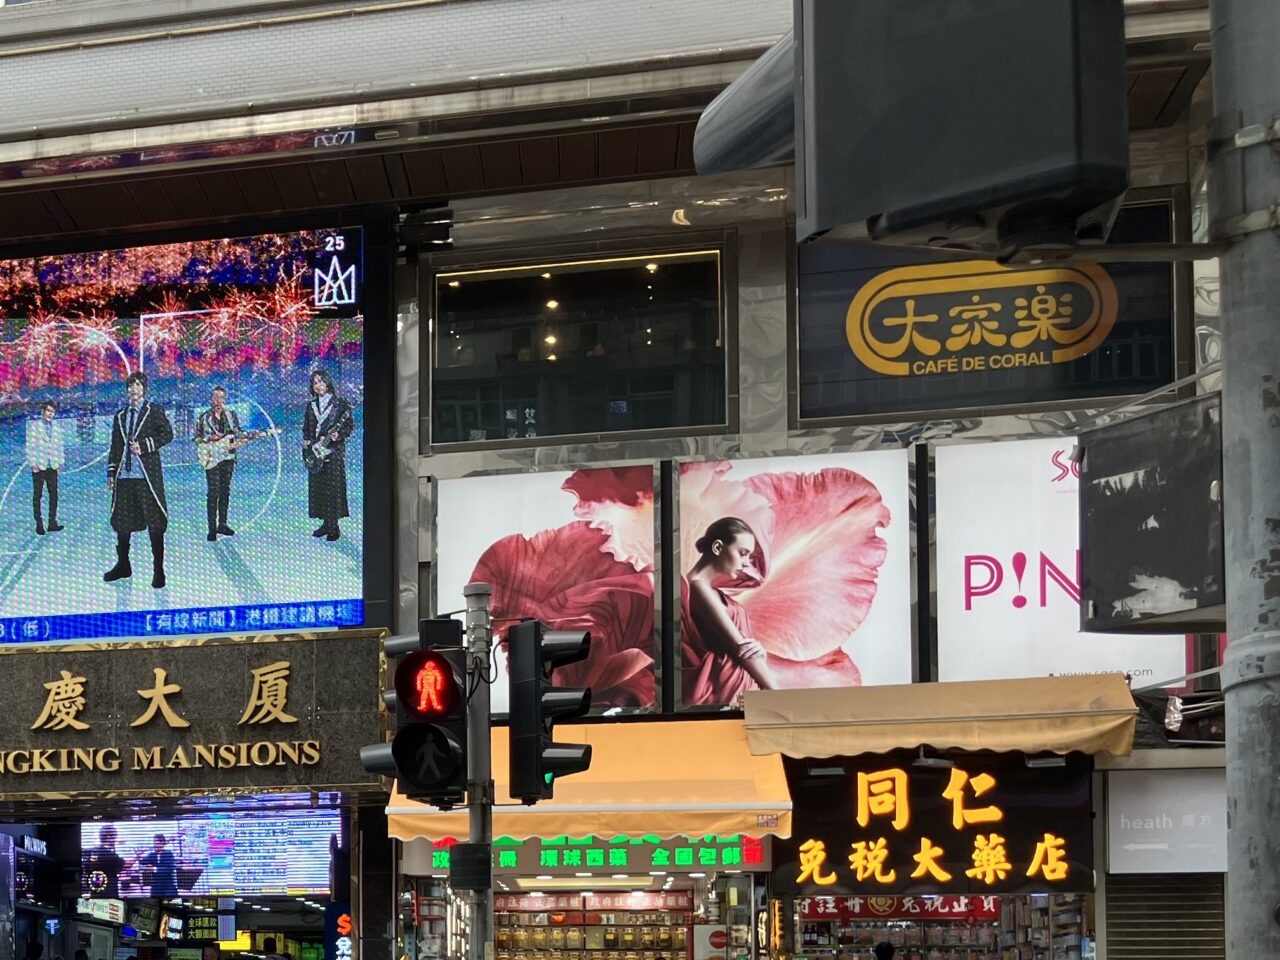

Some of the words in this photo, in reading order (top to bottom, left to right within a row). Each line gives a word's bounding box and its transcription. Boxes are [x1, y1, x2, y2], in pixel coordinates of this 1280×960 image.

[325, 236, 345, 251] 25
[913, 355, 958, 375] CAFÉ
[962, 357, 986, 371] DE
[989, 351, 1051, 369] CORAL
[132, 740, 320, 770] MANSIONS
[856, 766, 1004, 831] 同仁
[1120, 813, 1173, 830] heath
